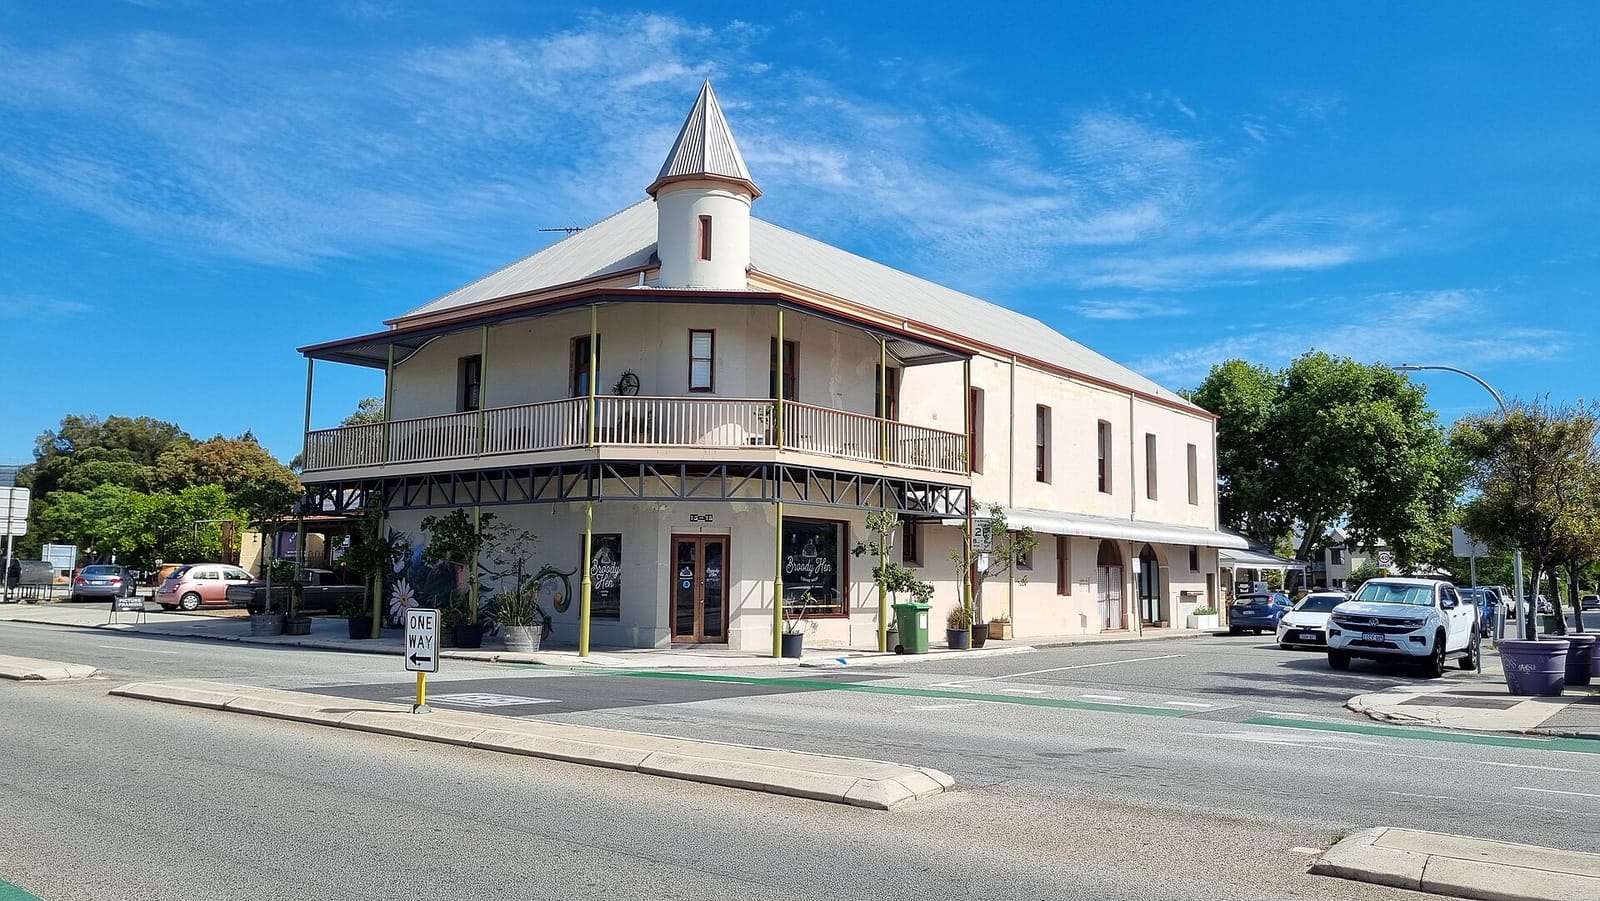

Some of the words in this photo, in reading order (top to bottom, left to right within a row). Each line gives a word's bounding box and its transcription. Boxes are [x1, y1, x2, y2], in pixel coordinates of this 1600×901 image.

[591, 559, 620, 579] Broody
[786, 556, 814, 577] Broody
[815, 558, 832, 573] Hen
[595, 573, 614, 589] Hen
[410, 616, 432, 629] ONE
[409, 634, 432, 648] WAY
